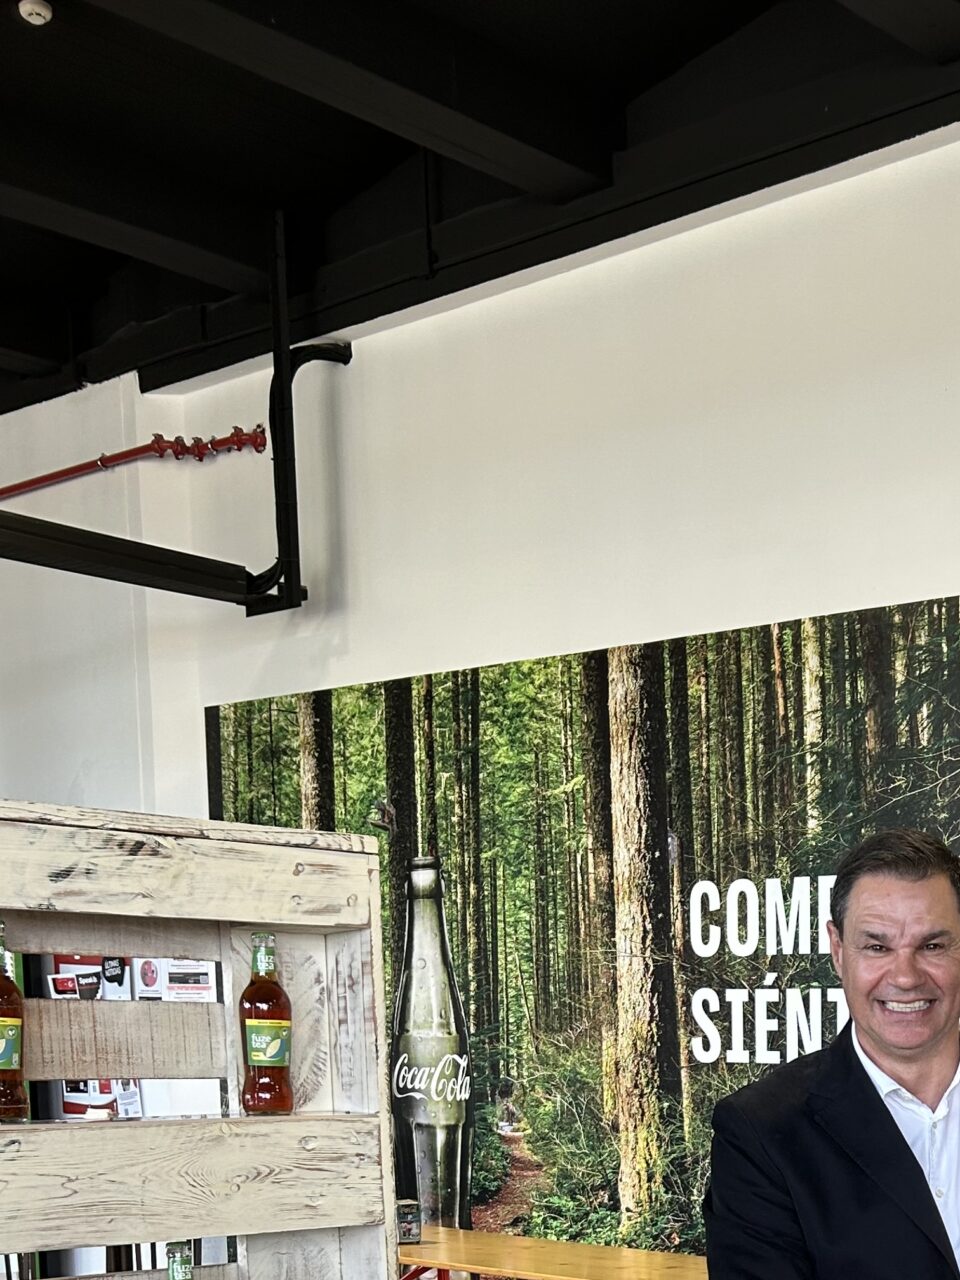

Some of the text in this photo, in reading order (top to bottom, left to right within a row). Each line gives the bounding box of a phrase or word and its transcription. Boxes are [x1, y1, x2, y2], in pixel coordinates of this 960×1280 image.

[257, 961, 275, 970] tea
[251, 1033, 272, 1043] fuze
[251, 1041, 267, 1049] tea
[392, 1052, 472, 1102] Coca-Cola
[174, 1270, 192, 1280] tea
